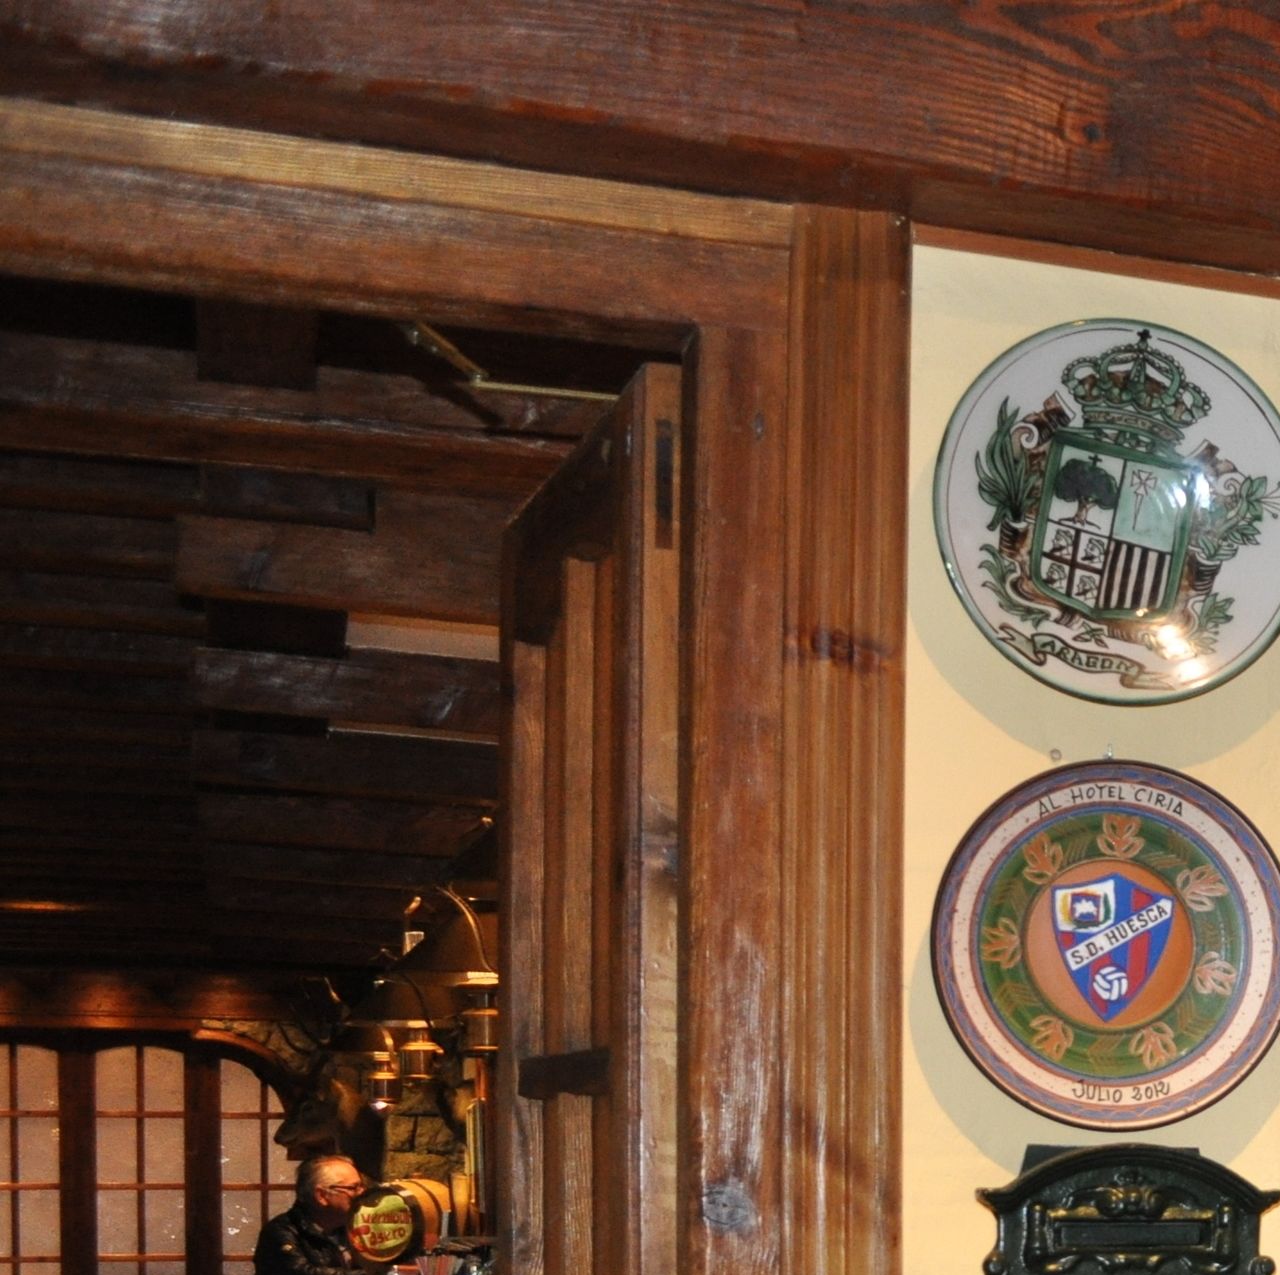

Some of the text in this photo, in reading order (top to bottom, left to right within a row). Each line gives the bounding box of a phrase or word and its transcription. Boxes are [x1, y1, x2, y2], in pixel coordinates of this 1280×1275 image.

[1039, 640, 1136, 671] ARAGON
[1038, 784, 1183, 817] AL HOTEL CIRIA
[1105, 904, 1168, 947] HUESCA
[1072, 1079, 1123, 1103] JULIO
